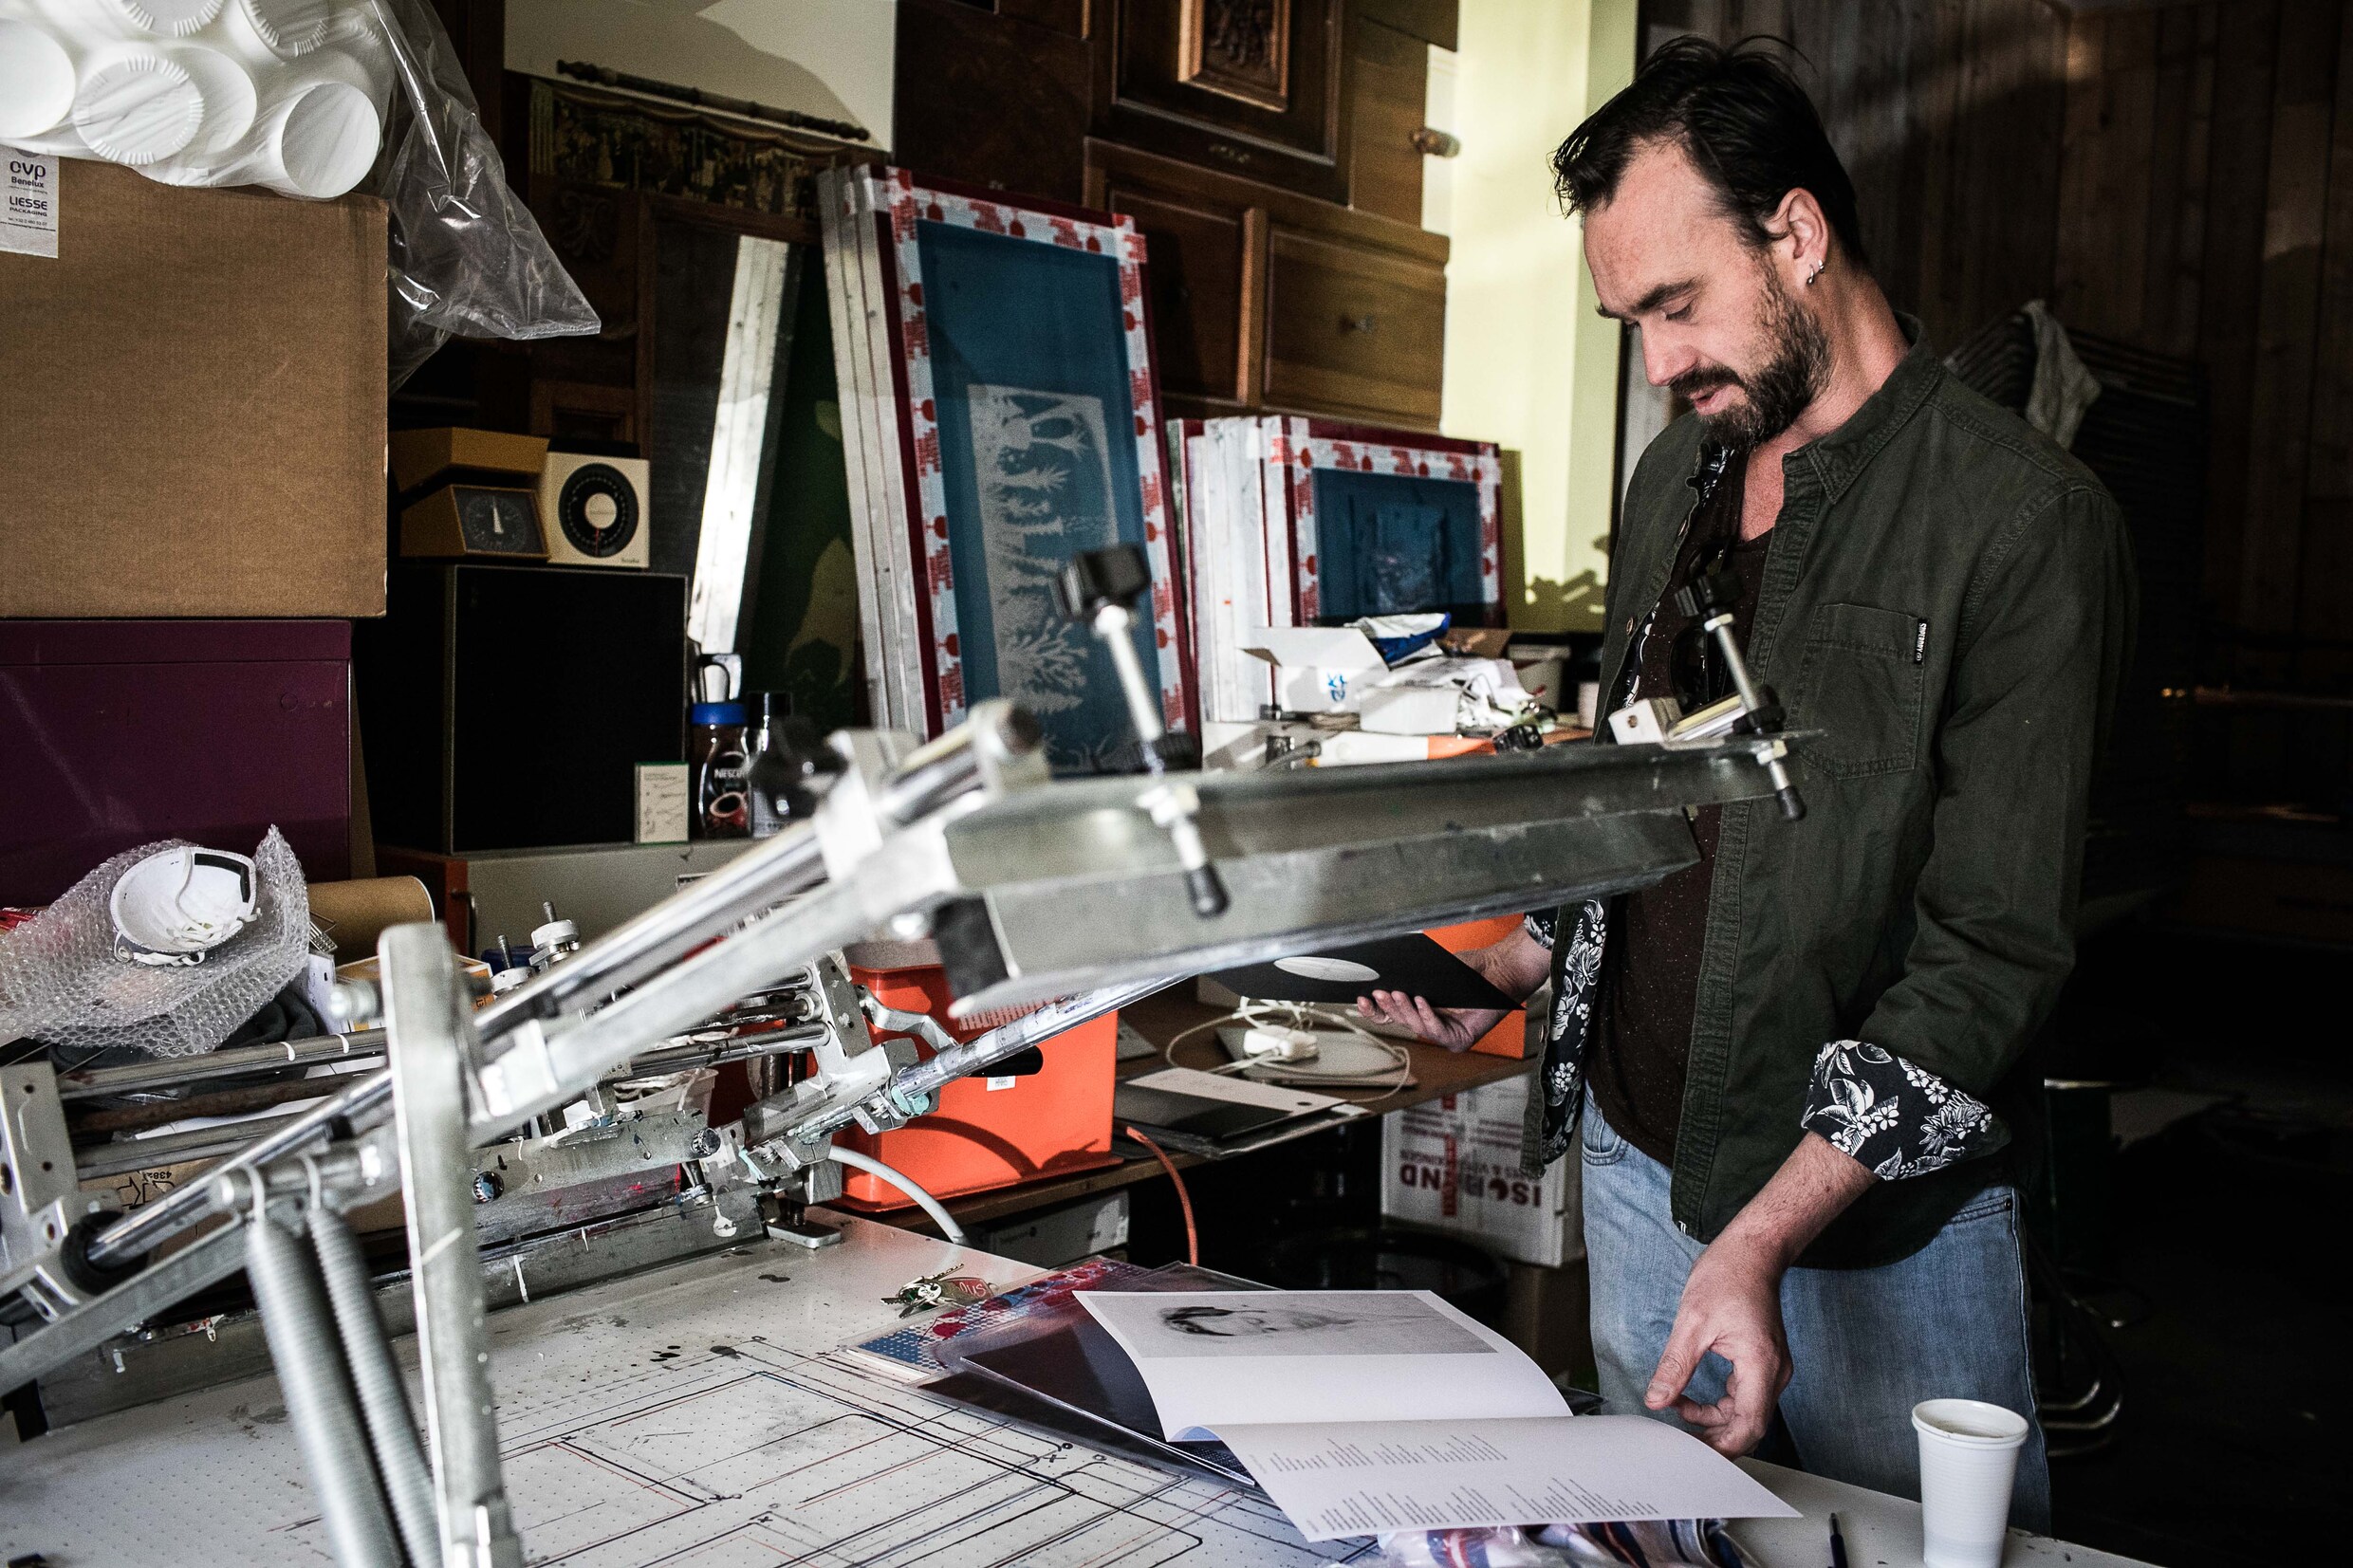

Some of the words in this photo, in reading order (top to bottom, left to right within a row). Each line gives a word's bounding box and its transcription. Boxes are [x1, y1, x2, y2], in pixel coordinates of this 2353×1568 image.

[10, 175, 45, 189] Benelux
[9, 195, 48, 211] LIESSE
[9, 207, 47, 217] PACKAGING
